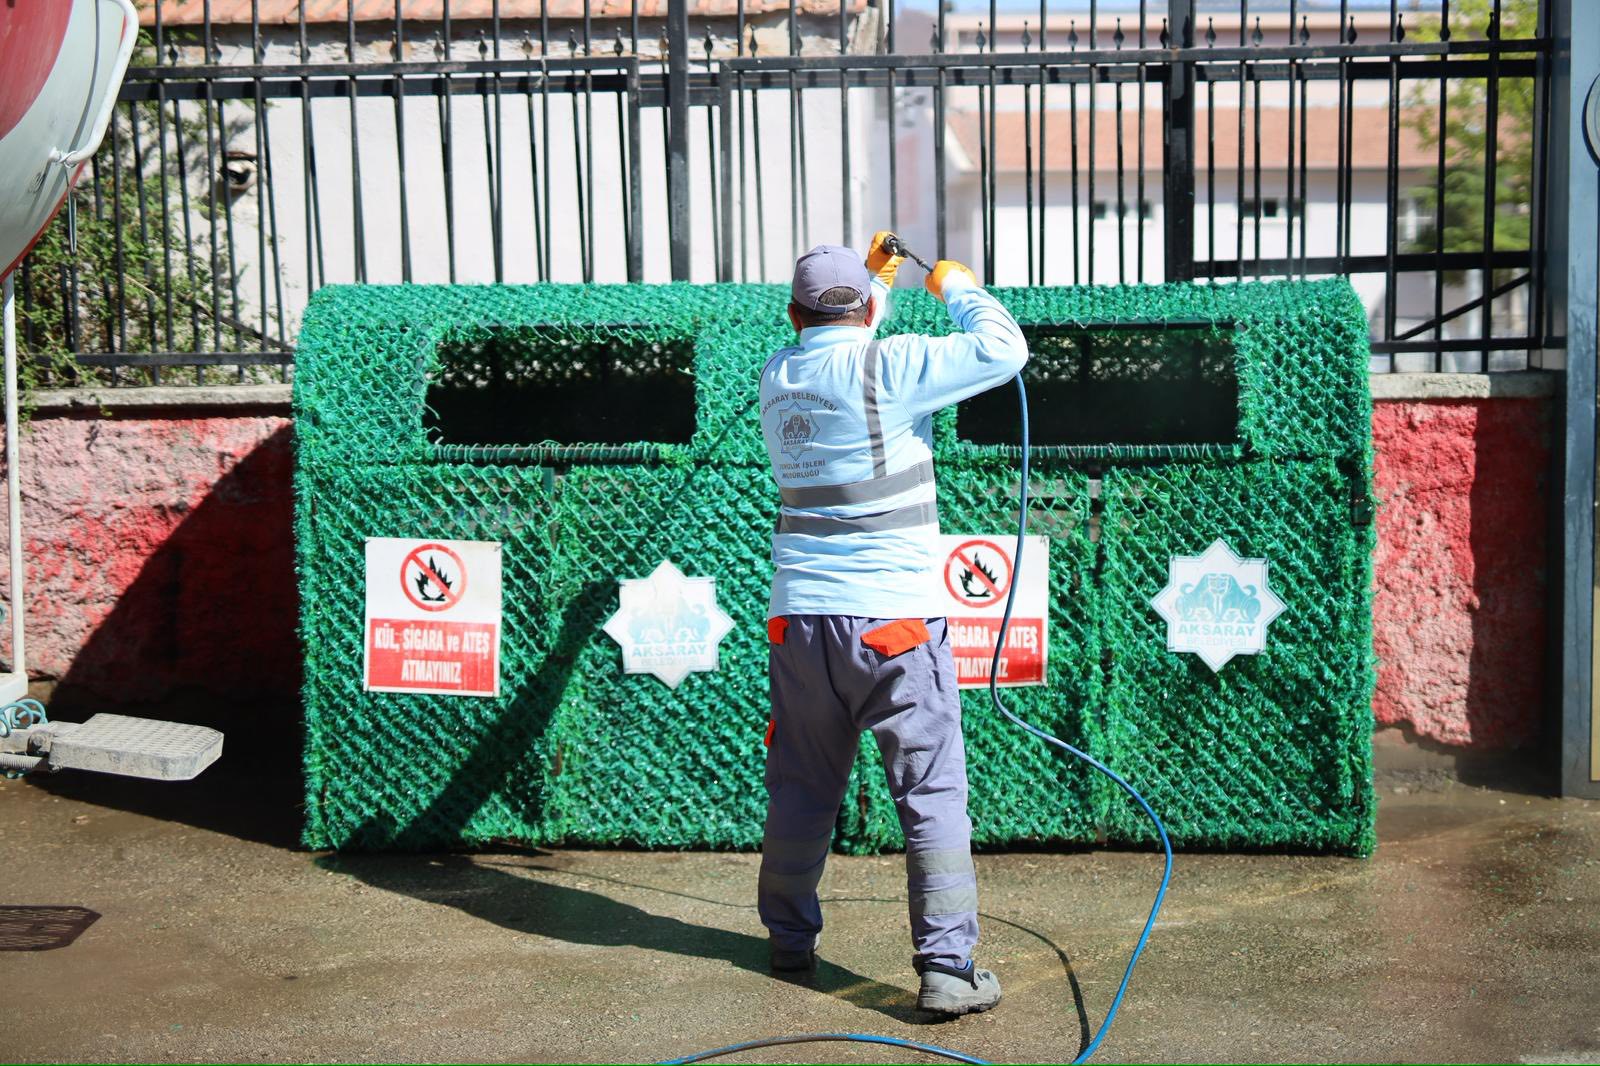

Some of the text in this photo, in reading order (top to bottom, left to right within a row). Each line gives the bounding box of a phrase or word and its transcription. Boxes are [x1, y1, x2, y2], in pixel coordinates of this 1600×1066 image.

[375, 622, 490, 660] KÜL, SİGARA ve ATEŞ
[992, 631, 1006, 649] v
[1008, 625, 1038, 655] ATEŞ
[1177, 623, 1257, 637] AKSARAY
[631, 643, 707, 657] AKSARAY
[401, 659, 462, 683] ATMAYINIZ
[953, 656, 1009, 678] TMAYIIZ
